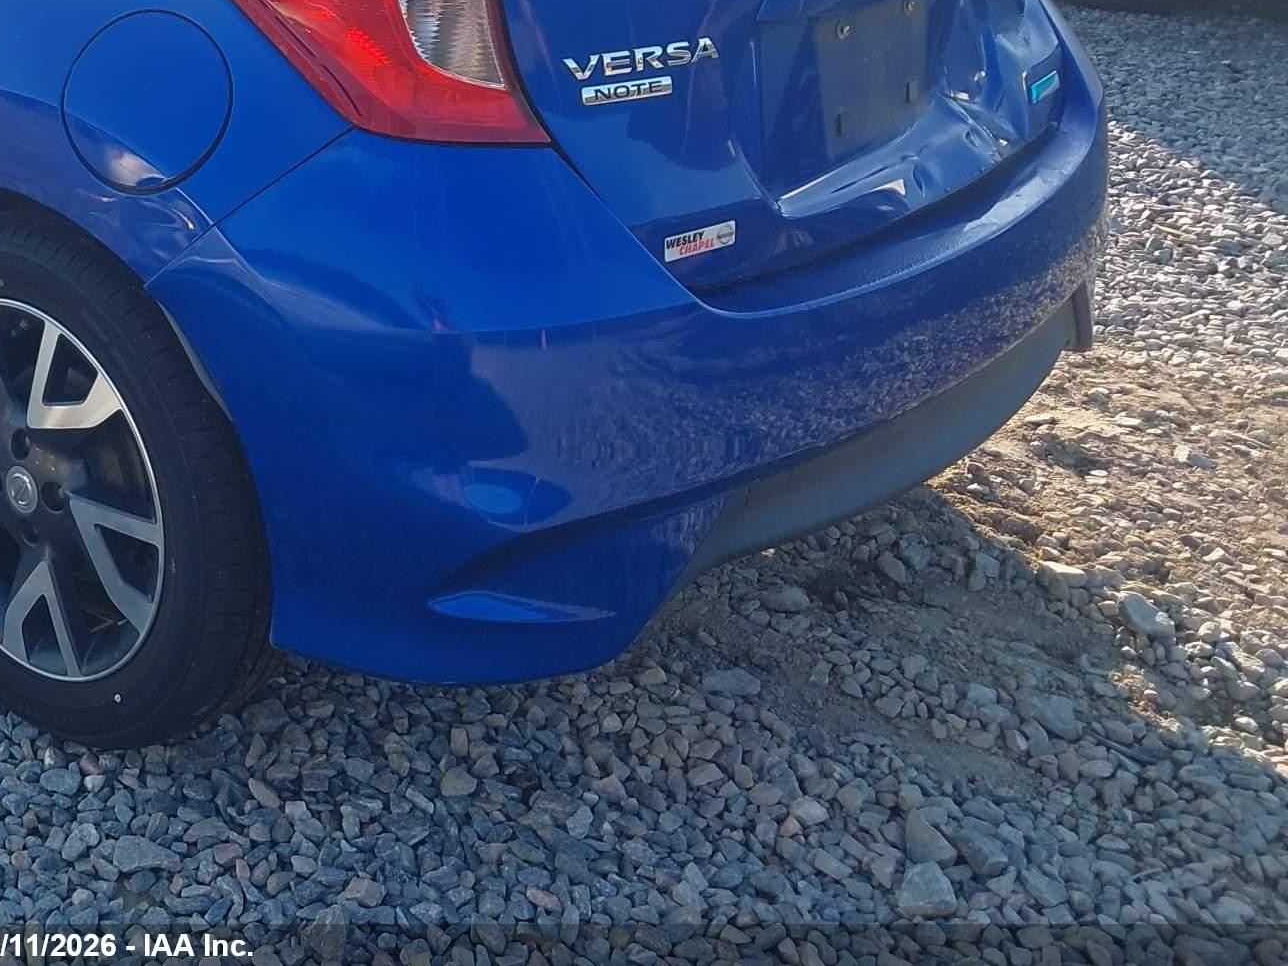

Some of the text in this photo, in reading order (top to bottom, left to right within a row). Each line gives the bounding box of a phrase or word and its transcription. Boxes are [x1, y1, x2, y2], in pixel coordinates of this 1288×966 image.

[562, 36, 719, 81] VERSA
[594, 80, 663, 101] NOTE
[666, 230, 705, 250] WESLEY
[679, 237, 715, 256] CHAPEL
